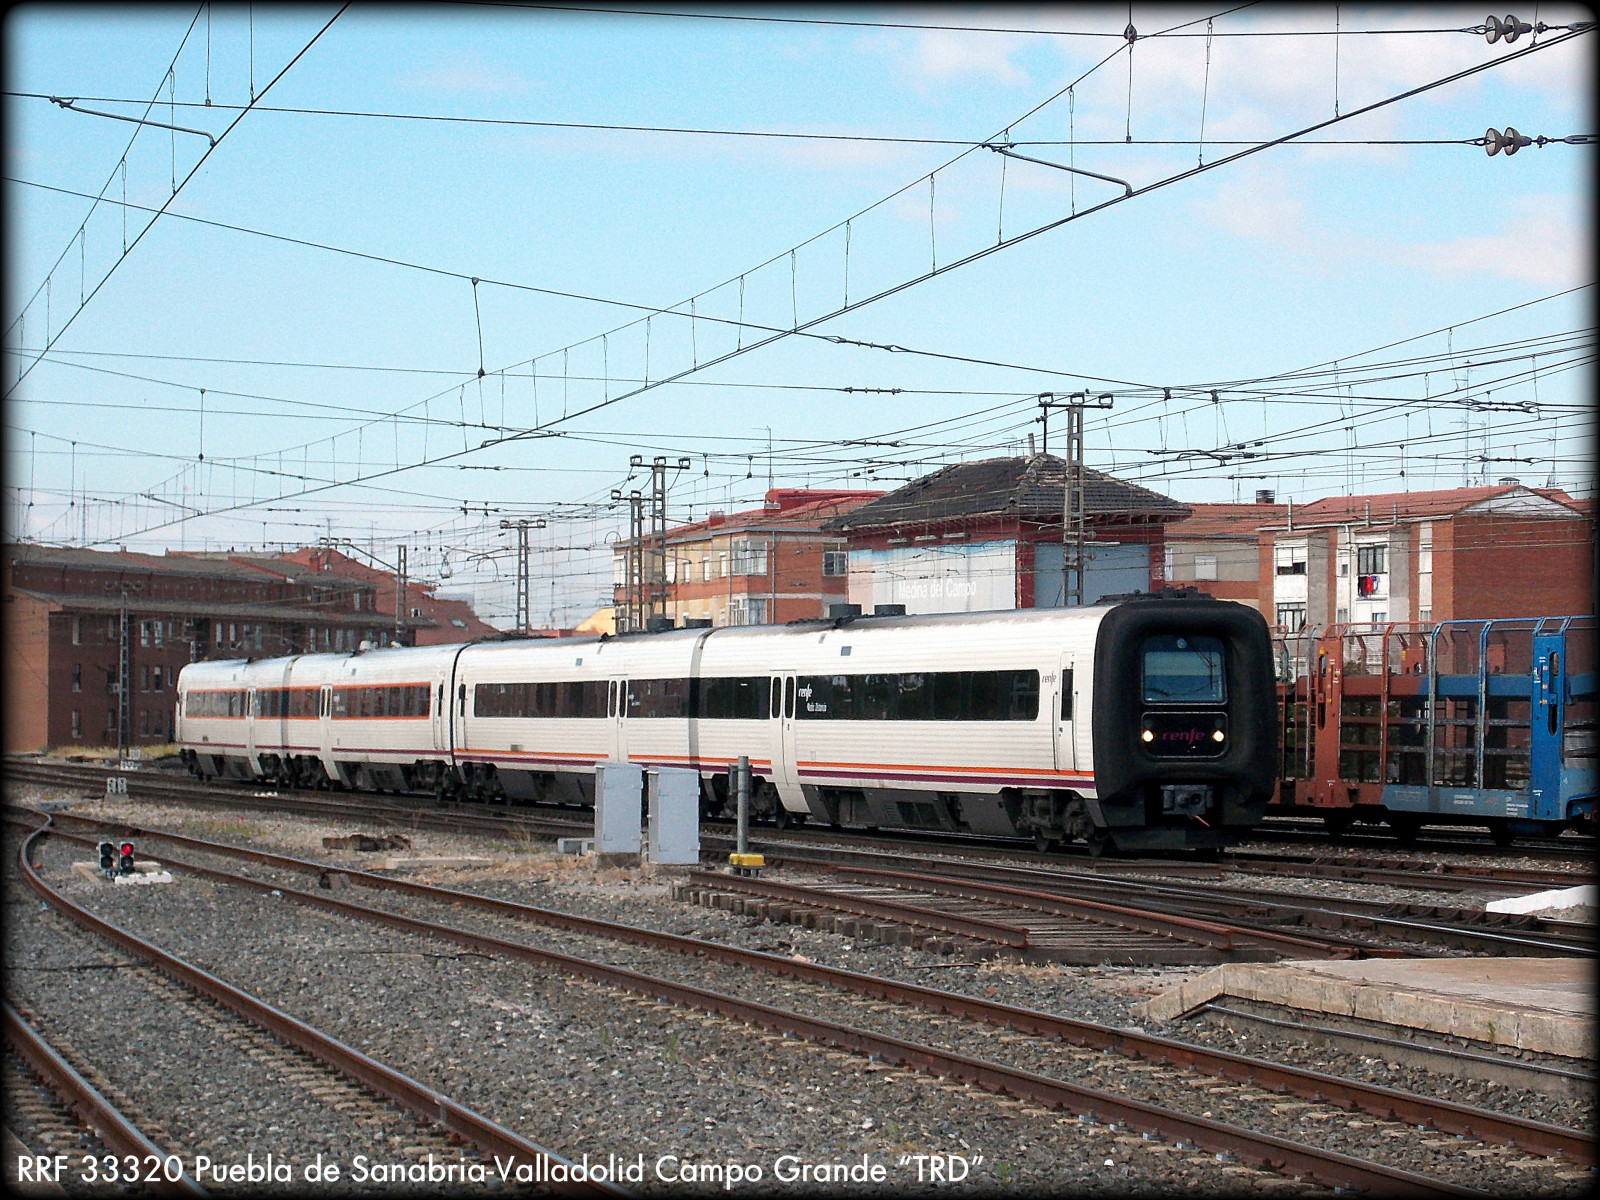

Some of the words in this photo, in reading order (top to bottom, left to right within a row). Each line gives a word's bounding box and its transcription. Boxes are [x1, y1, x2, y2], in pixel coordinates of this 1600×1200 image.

[899, 580, 928, 599] Medina
[930, 578, 944, 598] del
[946, 578, 977, 600] Campo
[1041, 670, 1057, 688] renfe
[798, 683, 813, 702] renfe
[1162, 727, 1206, 746] renfe
